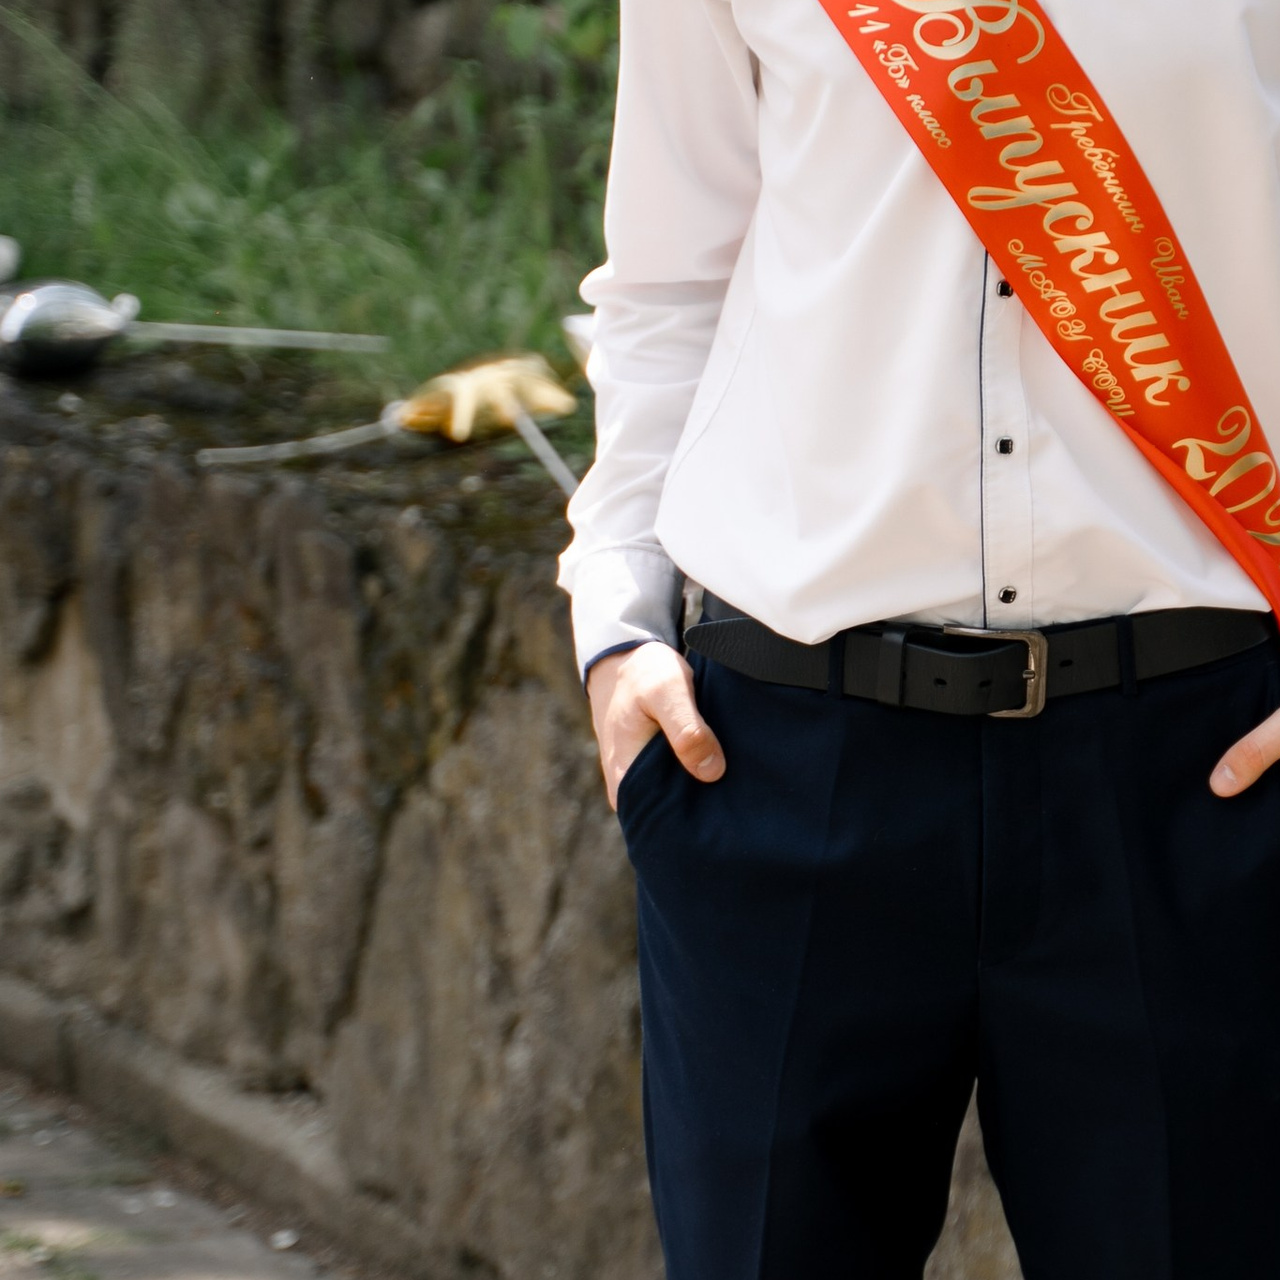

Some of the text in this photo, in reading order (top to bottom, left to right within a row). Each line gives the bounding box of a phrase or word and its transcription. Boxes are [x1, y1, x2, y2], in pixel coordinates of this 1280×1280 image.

[847, 3, 952, 149] 11 «Б» класс
[1046, 83, 1189, 320] Гребёнкин Иван
[1007, 238, 1094, 342] МАОУ
